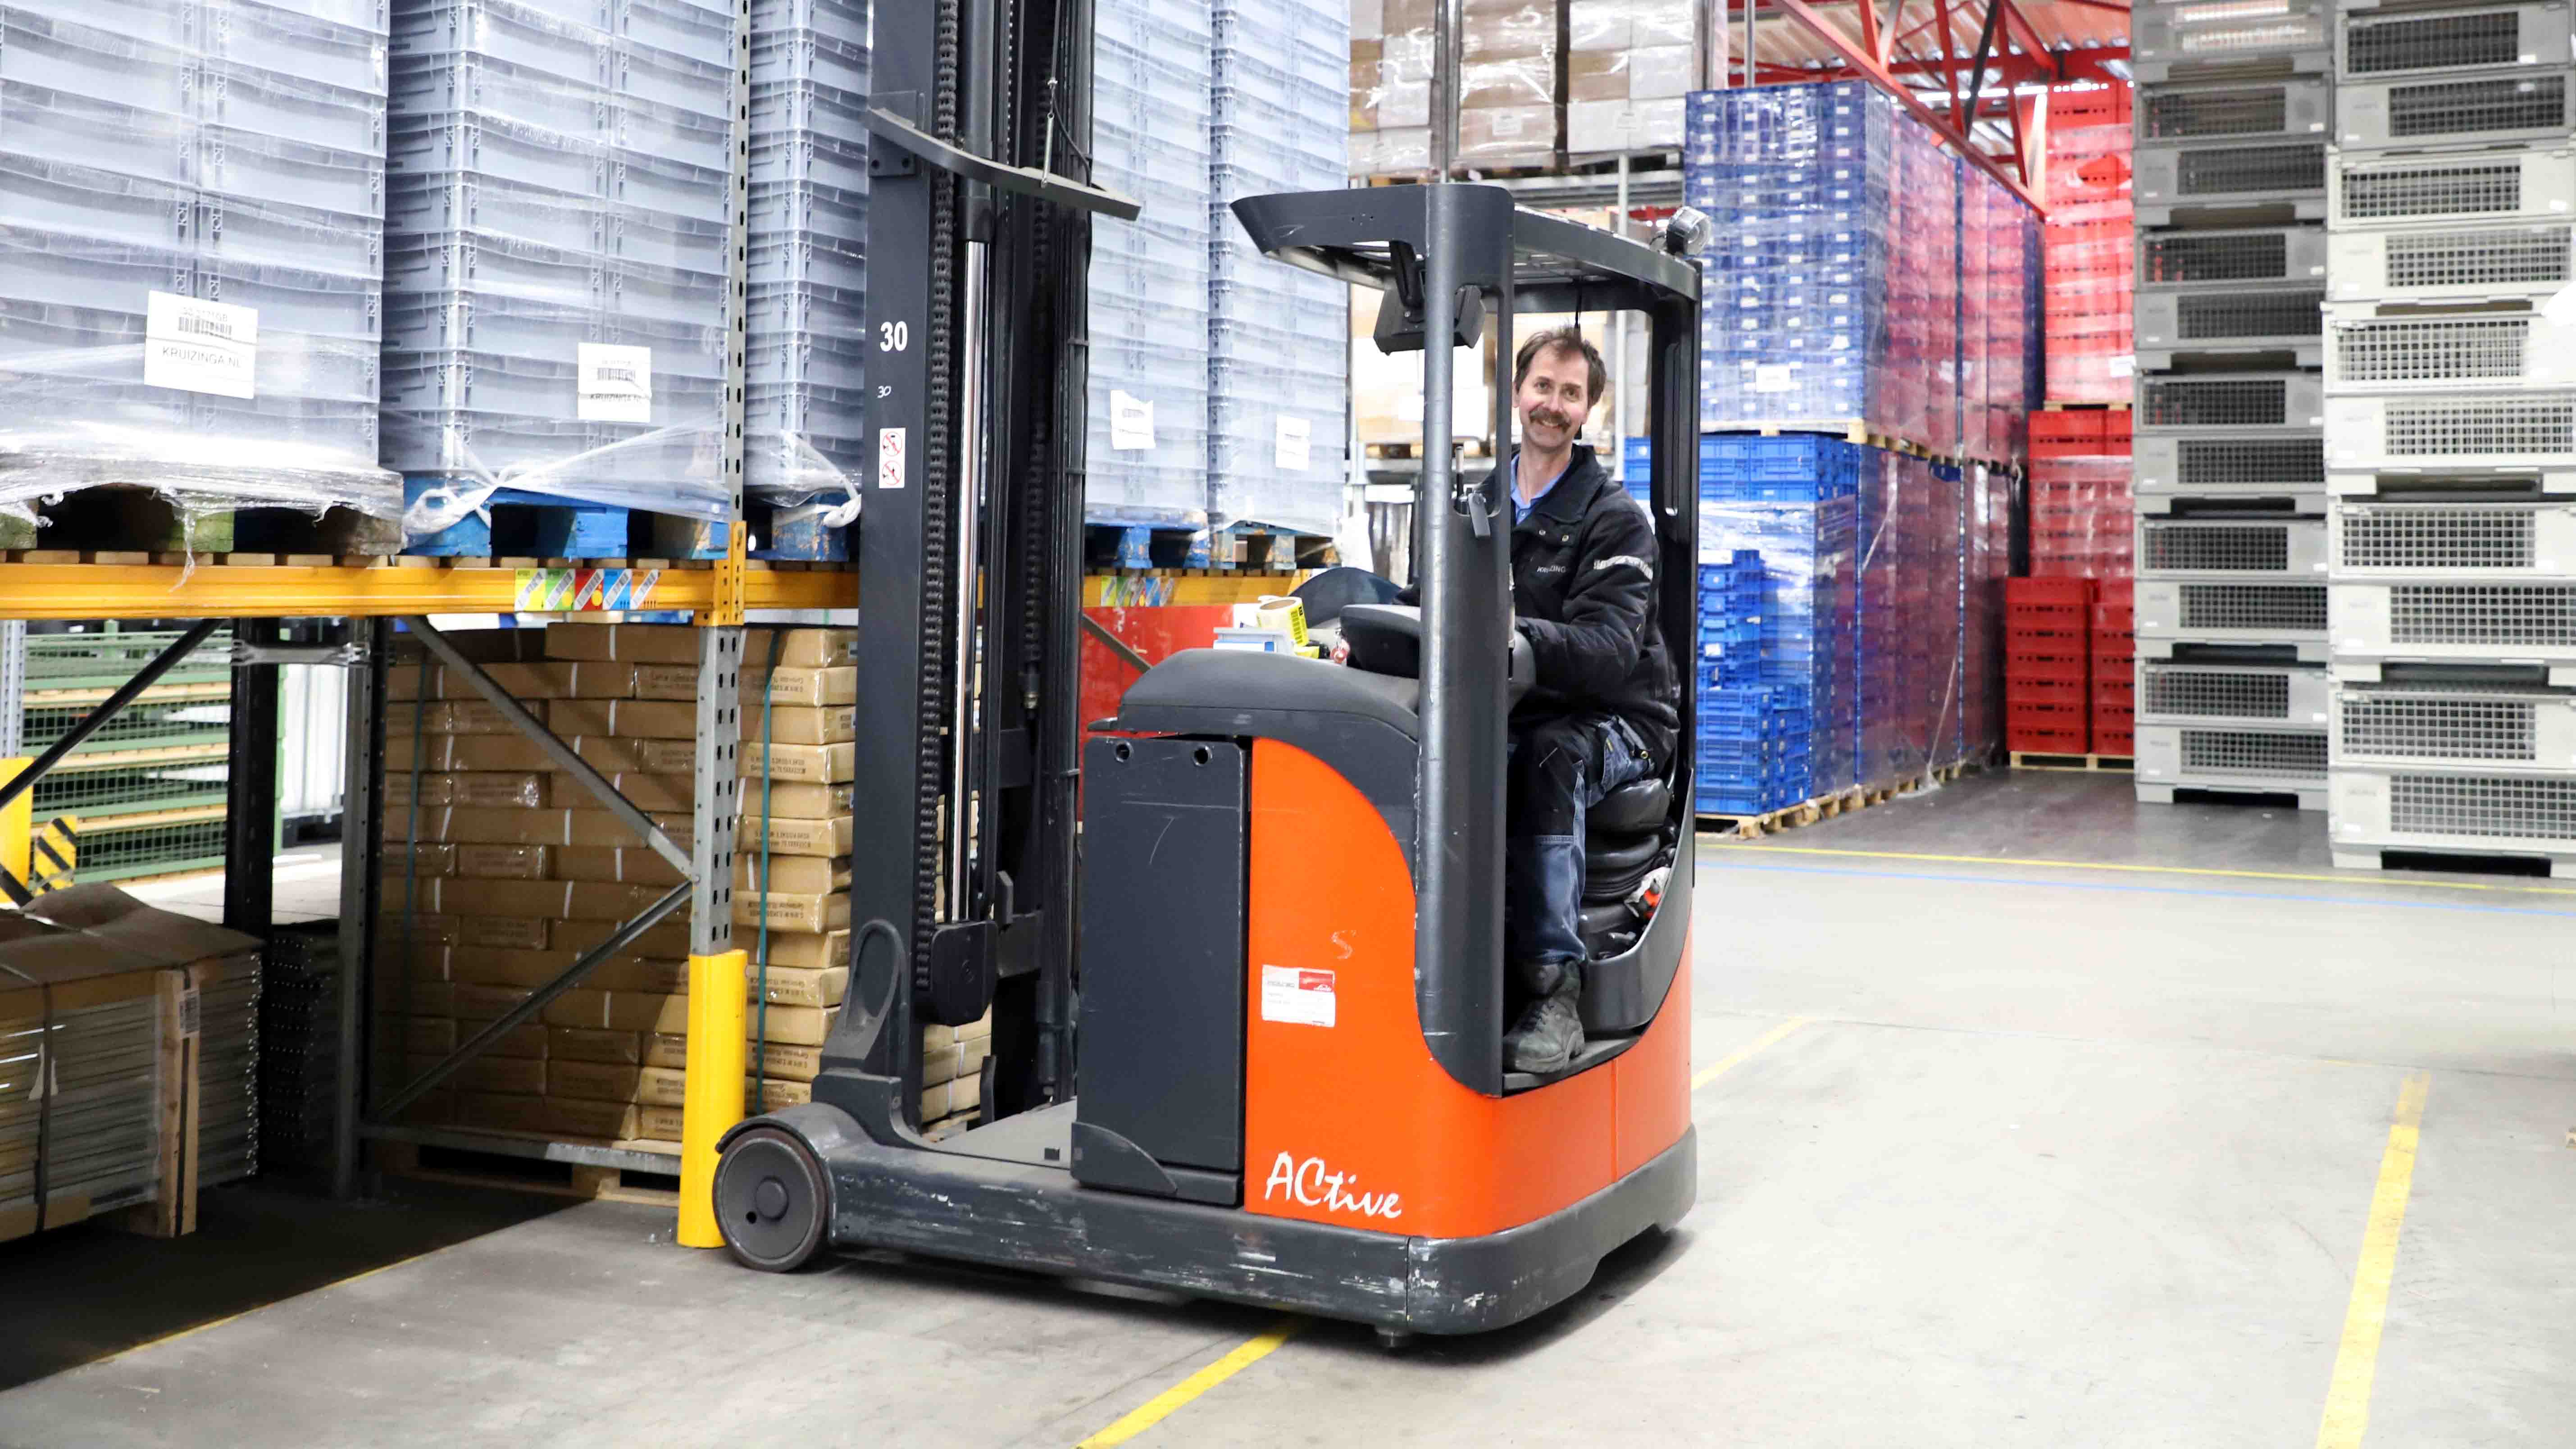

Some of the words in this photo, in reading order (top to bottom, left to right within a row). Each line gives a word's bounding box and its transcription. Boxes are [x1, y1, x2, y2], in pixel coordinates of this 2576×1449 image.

[880, 321, 908, 352] 30
[162, 346, 241, 368] KRUIZINGANL
[877, 385, 892, 398] 30
[1265, 1150, 1402, 1218] ACtive
